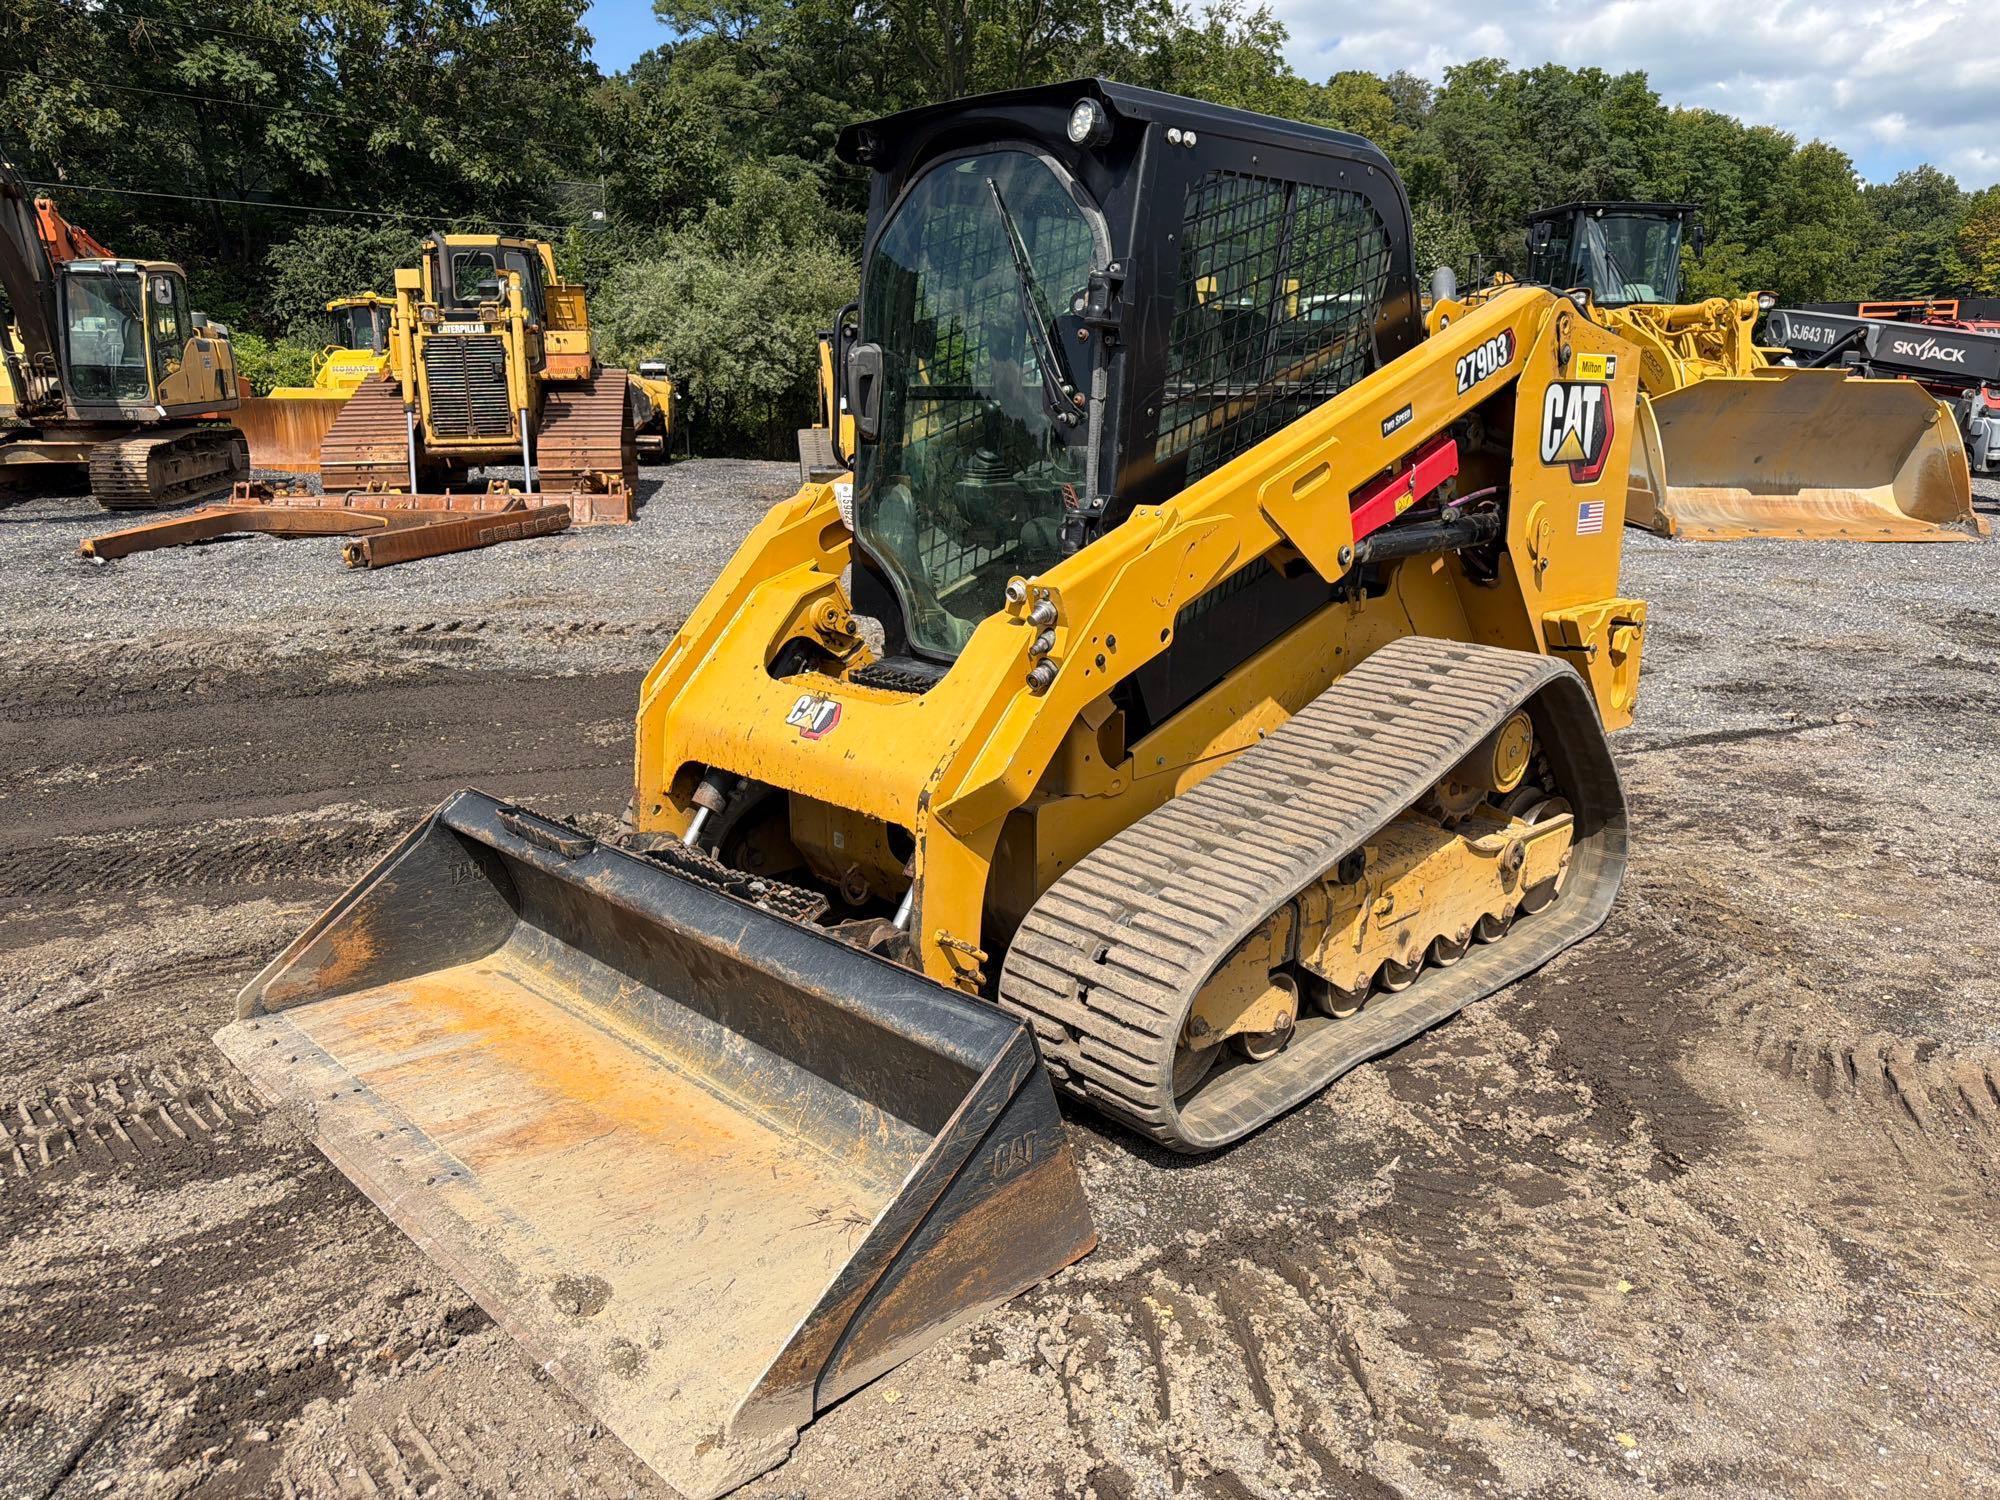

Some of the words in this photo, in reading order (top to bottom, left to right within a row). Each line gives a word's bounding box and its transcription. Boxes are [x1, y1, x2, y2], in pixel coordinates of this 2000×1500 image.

[437, 324, 485, 334] CATERPILLAR
[1791, 324, 1821, 342] SJ643
[1823, 328, 1836, 345] TH
[1456, 333, 1508, 394] 279D3
[1892, 337, 1966, 363] SKYJACK
[1582, 361, 1601, 373] Milton
[1541, 384, 1602, 462] CAT
[785, 695, 837, 731] CAT
[993, 1130, 1037, 1178] CAT
